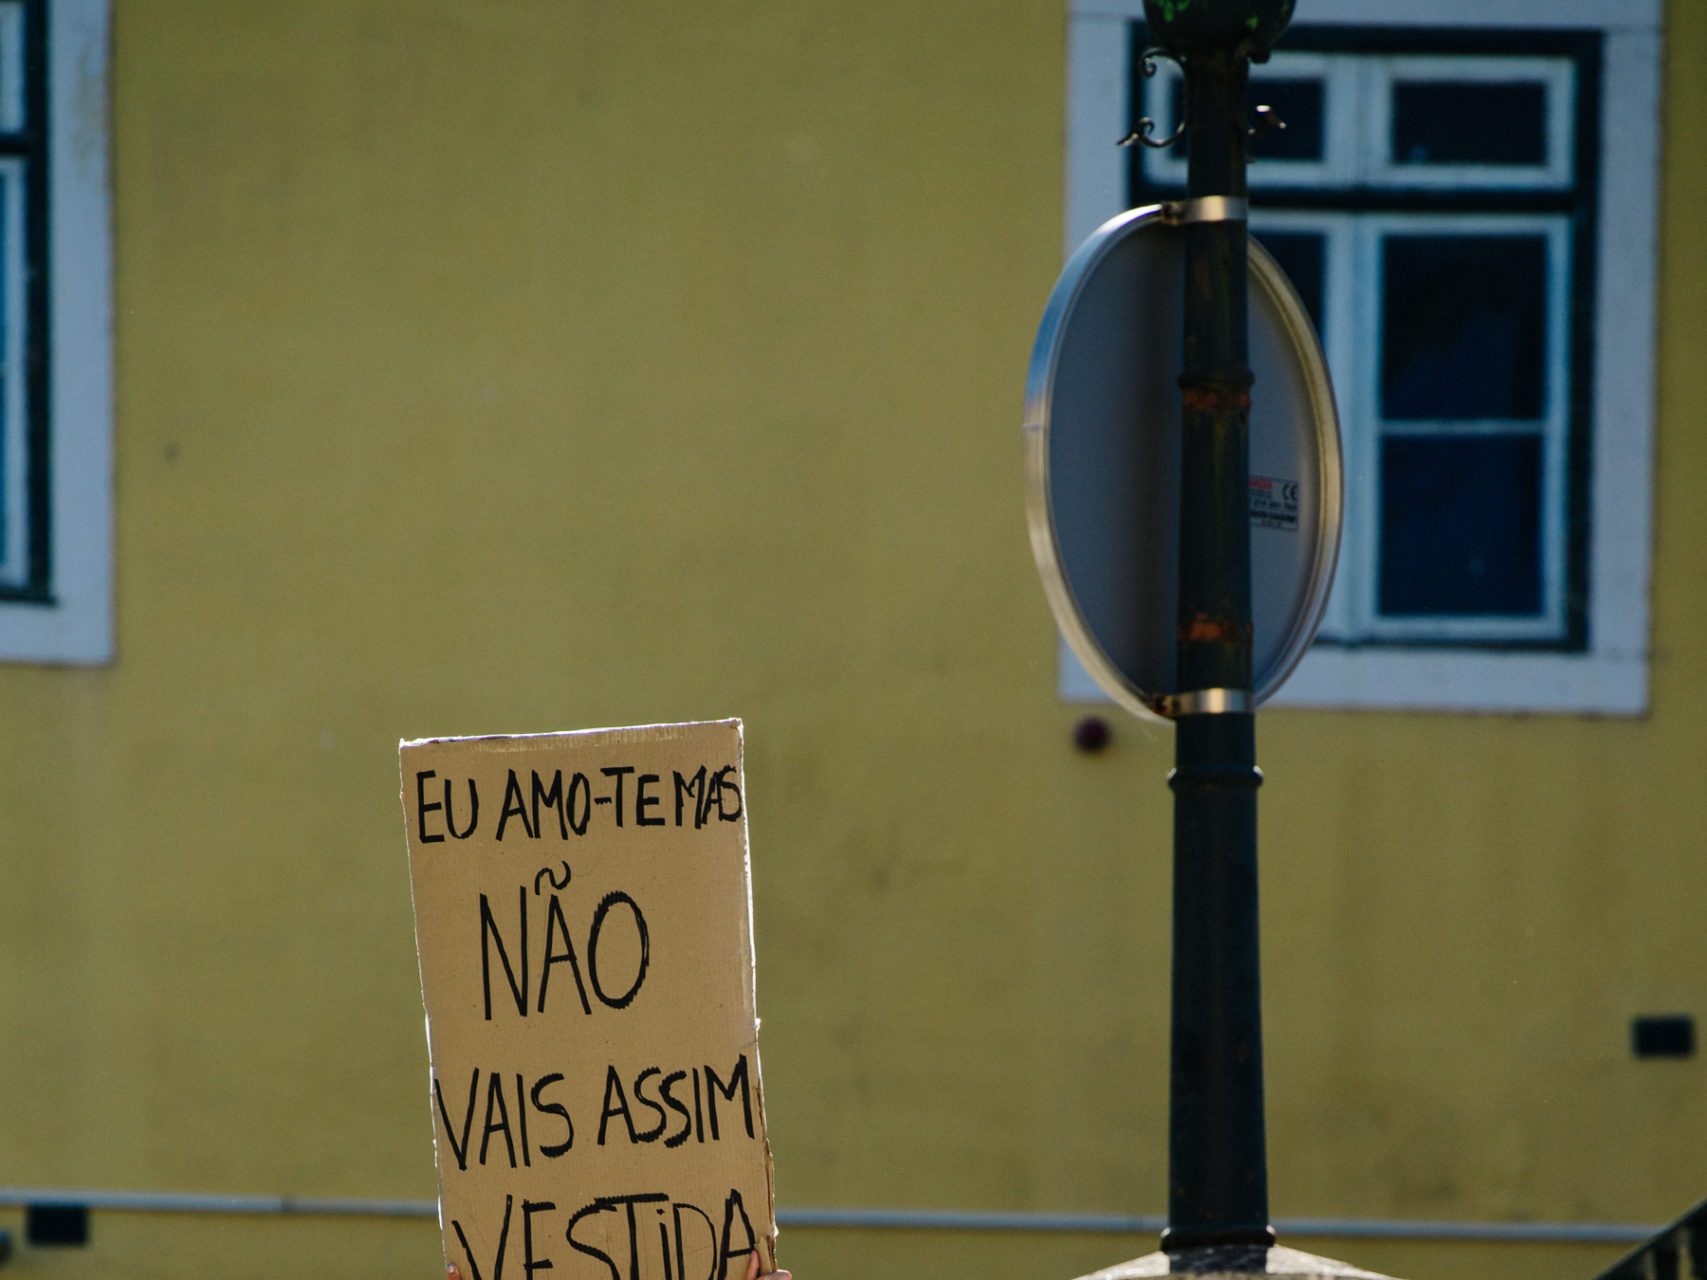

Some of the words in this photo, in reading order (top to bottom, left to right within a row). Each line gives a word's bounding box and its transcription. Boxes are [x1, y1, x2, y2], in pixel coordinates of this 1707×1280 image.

[416, 769, 479, 844] EU
[496, 766, 666, 841] AMO-TE
[673, 765, 744, 829] MAS
[479, 860, 650, 1020] NÃO
[434, 1067, 575, 1171] VAIS
[597, 1053, 756, 1149] ASSIM
